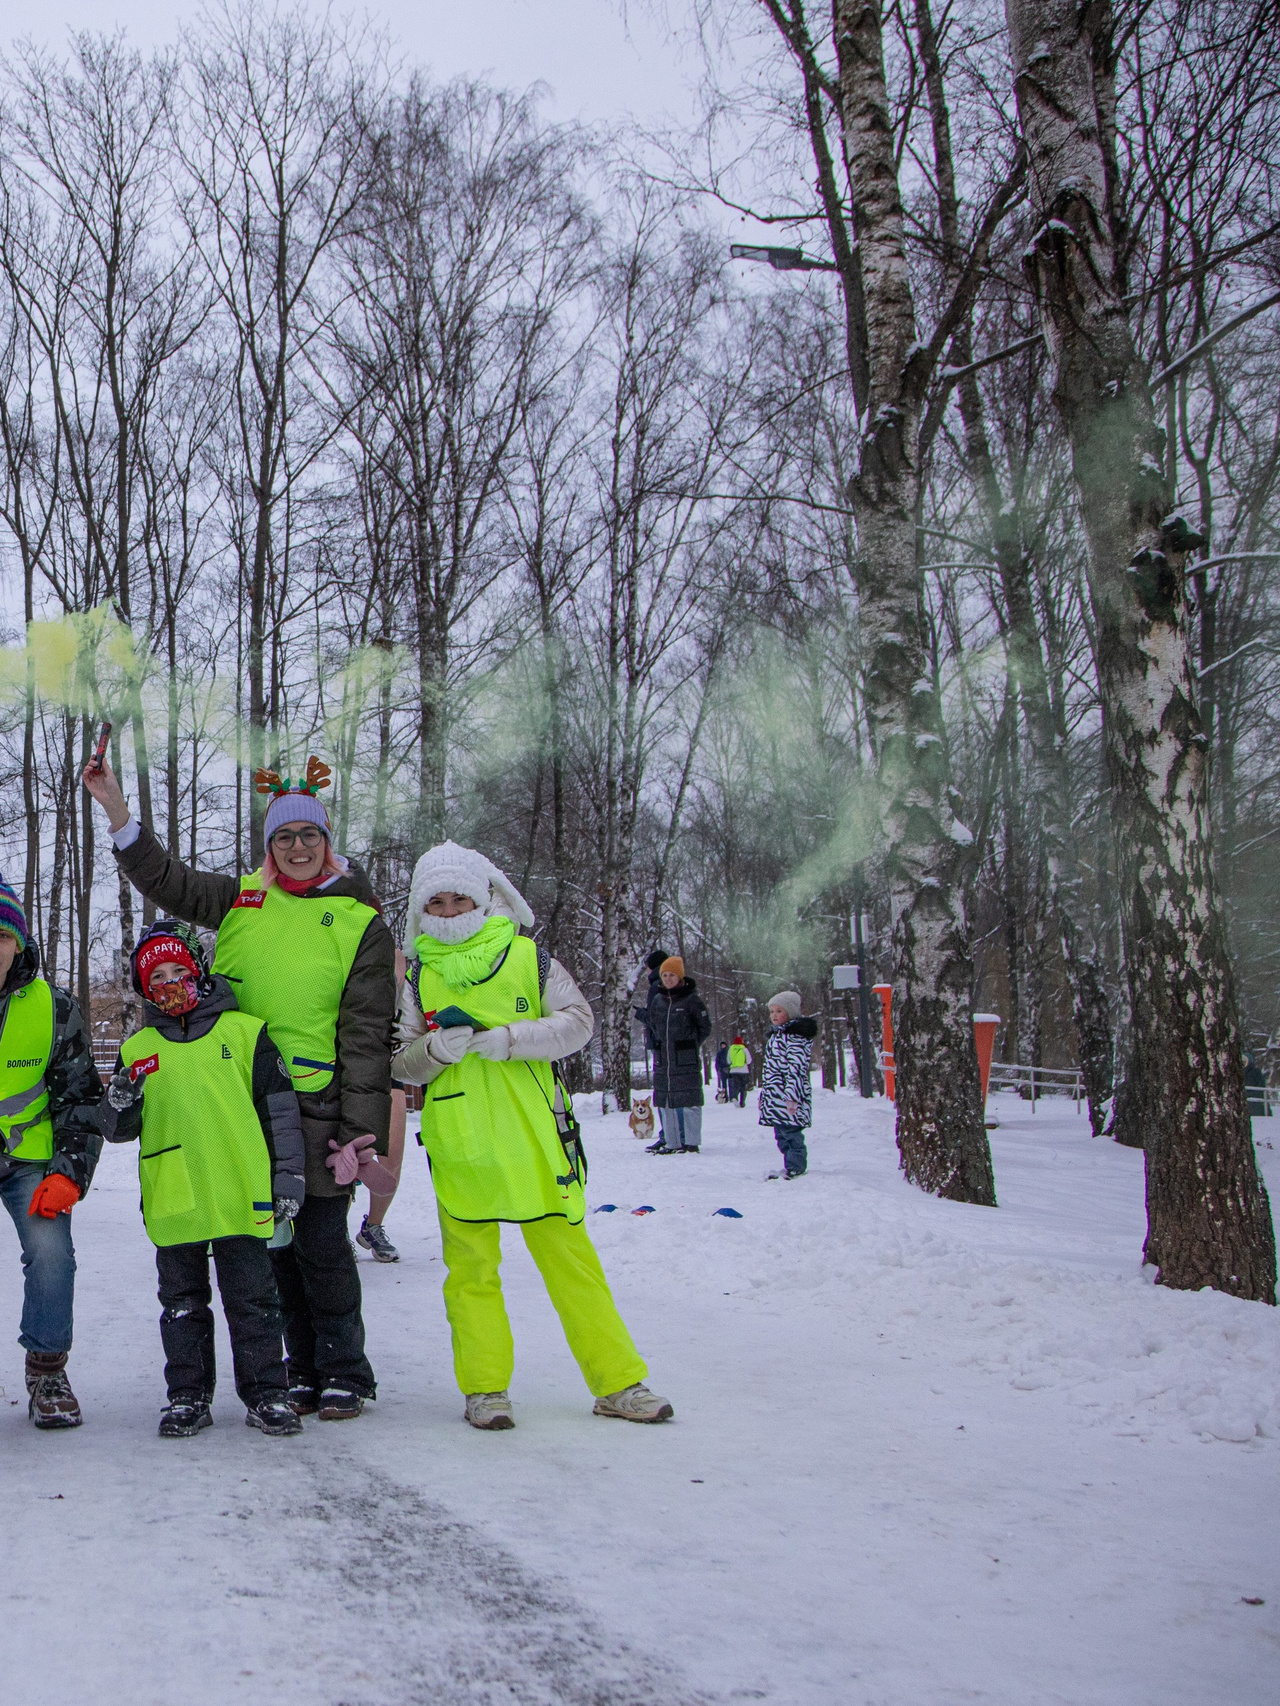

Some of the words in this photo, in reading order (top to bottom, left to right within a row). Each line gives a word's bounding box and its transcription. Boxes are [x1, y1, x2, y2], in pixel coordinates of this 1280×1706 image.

[140, 951, 151, 968] OFF
[154, 941, 182, 954] PATH
[7, 1058, 42, 1068] ВОЛОНТЕР
